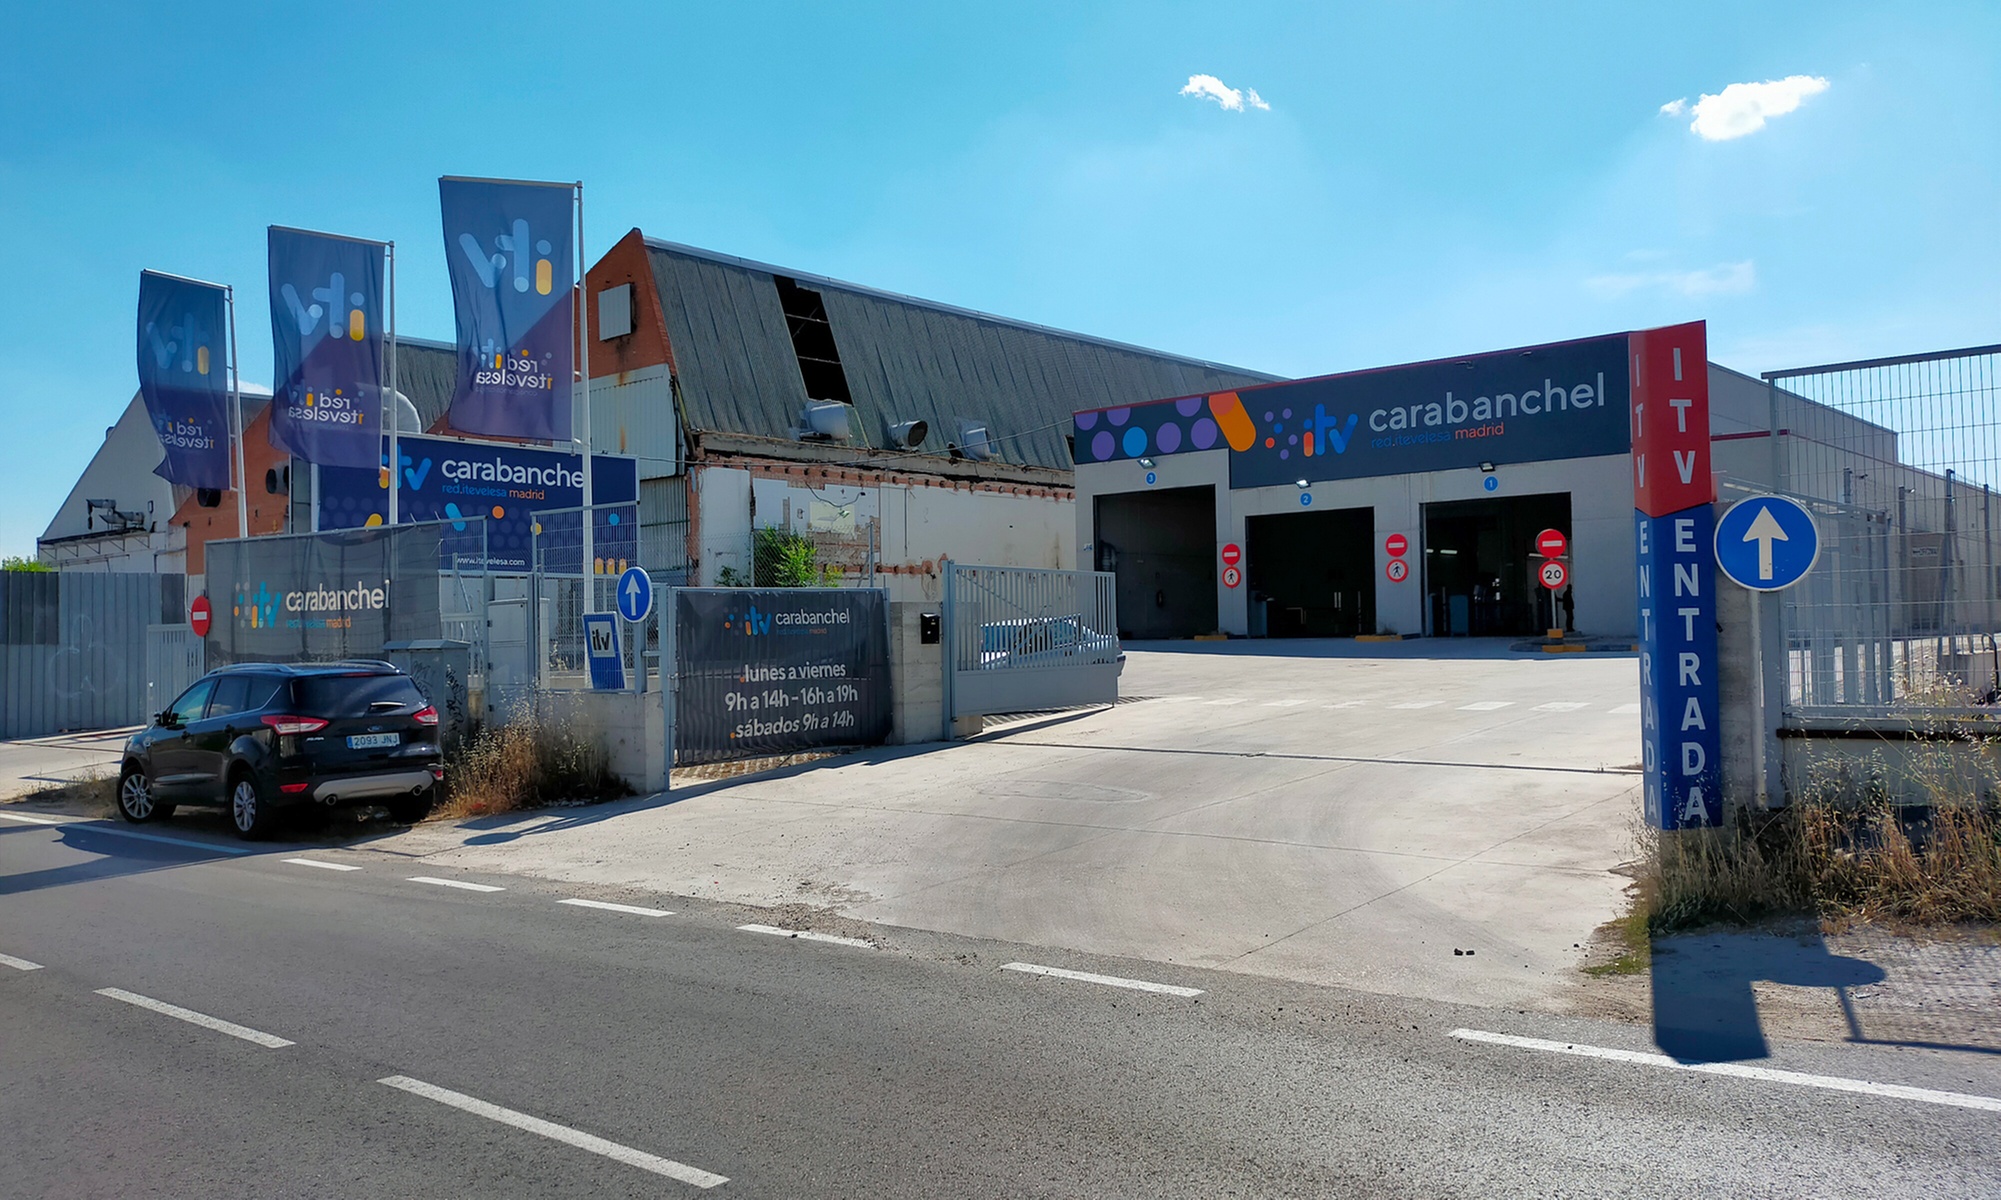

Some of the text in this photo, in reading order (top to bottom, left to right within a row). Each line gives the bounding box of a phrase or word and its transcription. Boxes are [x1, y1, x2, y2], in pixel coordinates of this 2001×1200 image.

[1303, 372, 1605, 457] itv carabanchel
[1669, 347, 1696, 484] ITV
[1455, 422, 1504, 439] madrid
[441, 457, 584, 488] carabanche
[509, 488, 545, 500] madrid
[1545, 569, 1562, 580] 20
[285, 579, 390, 611] carabanchel
[744, 605, 850, 636] itv carabanchel
[788, 666, 797, 679] a
[798, 661, 846, 678] viernes
[1639, 521, 1658, 820] ENTRADA
[1673, 518, 1709, 822] ENTRADA
[725, 692, 747, 711] 9h
[750, 696, 759, 709] a
[762, 689, 789, 708] 14h
[800, 686, 825, 705] 16h
[827, 690, 835, 703] a
[836, 684, 858, 702] 19h
[803, 713, 819, 731] 9h
[820, 716, 829, 728] a
[832, 710, 855, 728] 14h
[354, 735, 378, 746] 2093
